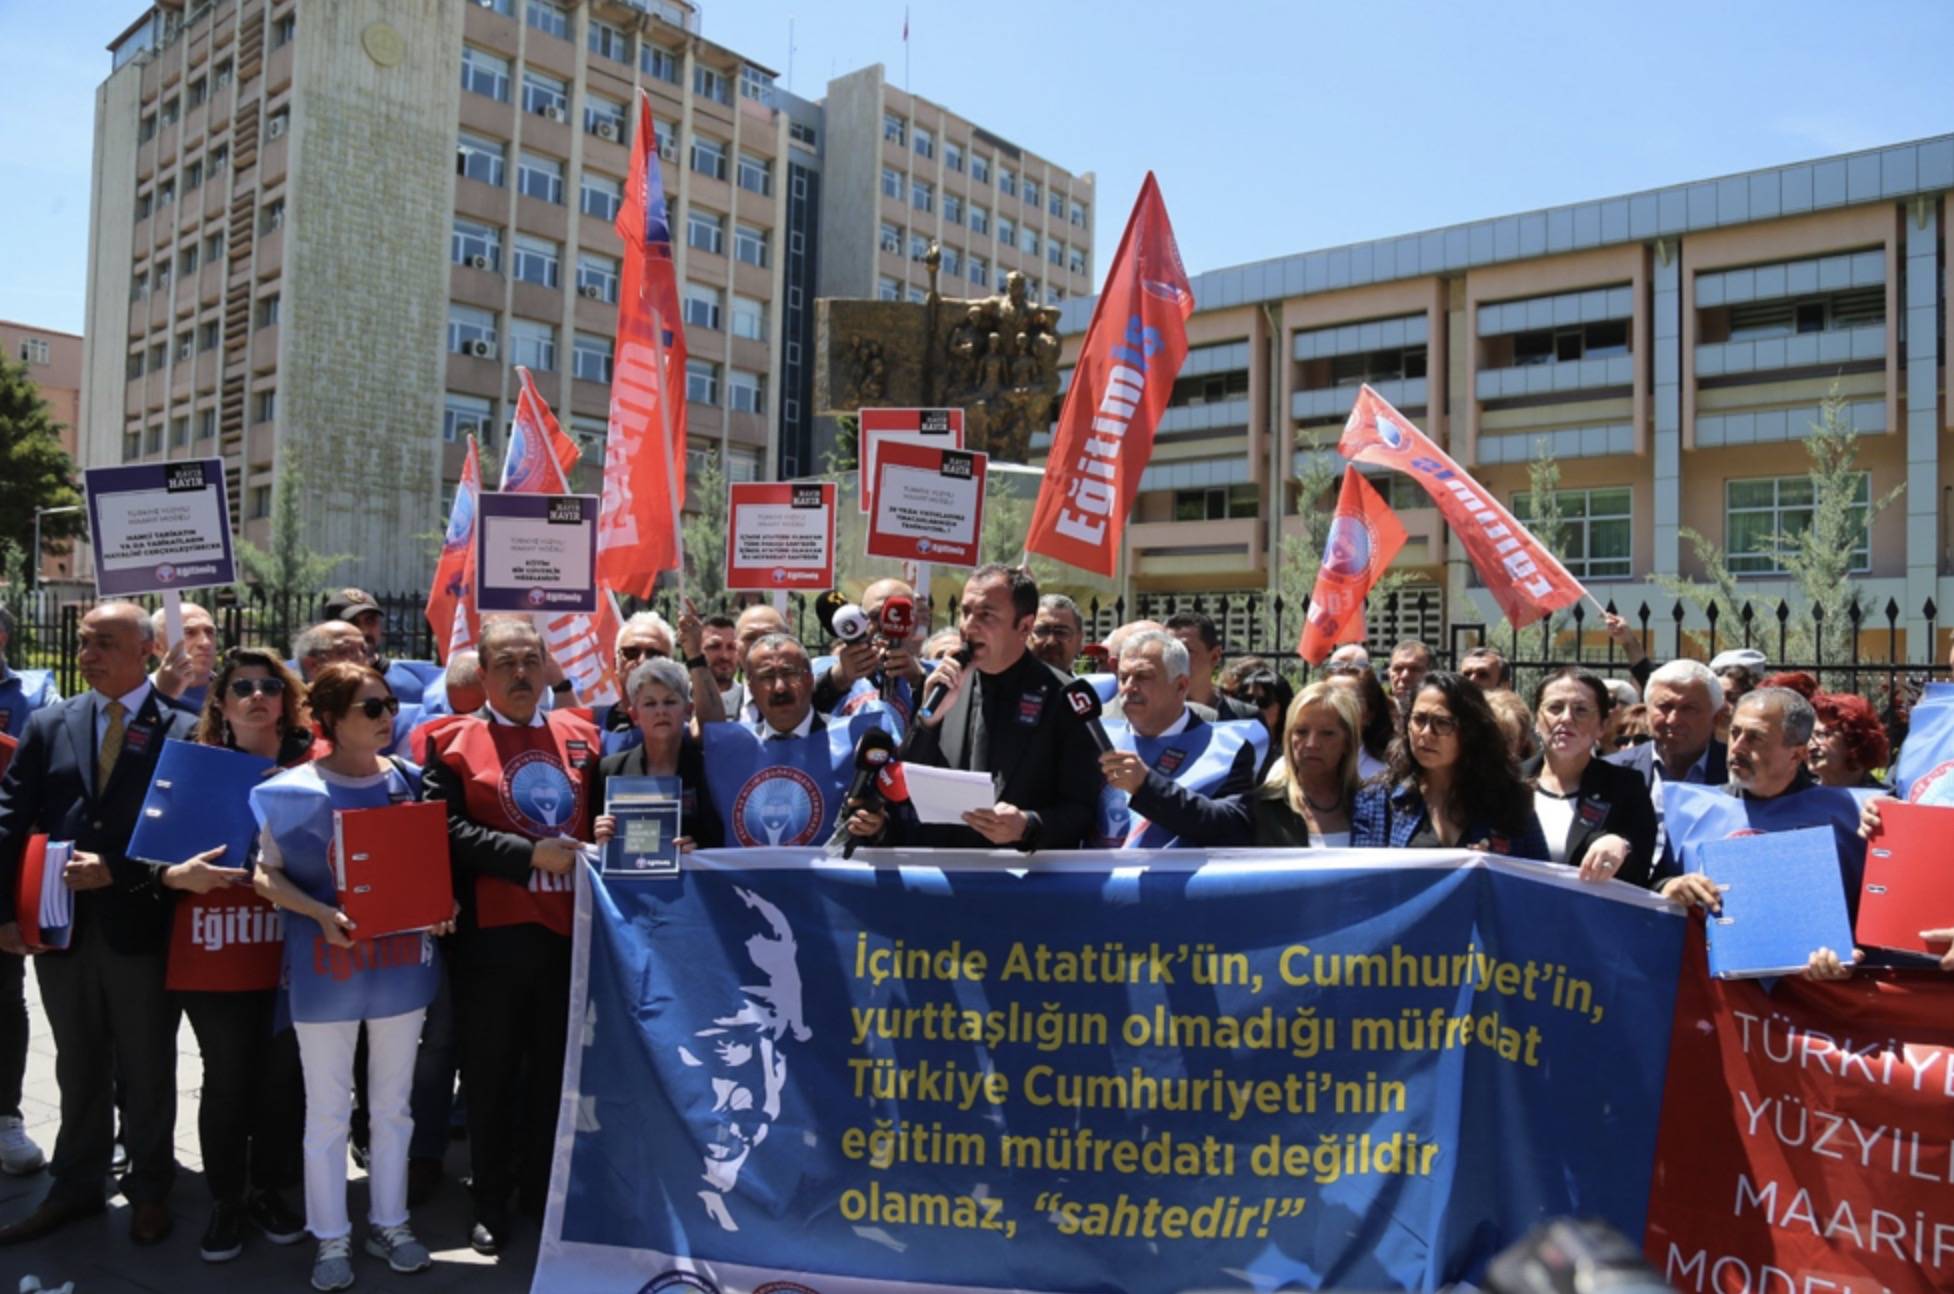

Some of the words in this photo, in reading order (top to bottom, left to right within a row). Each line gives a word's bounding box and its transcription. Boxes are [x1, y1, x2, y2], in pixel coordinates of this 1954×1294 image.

[168, 477, 204, 489] HAYIR
[549, 511, 581, 521] HAYIR
[855, 931, 988, 985] İçinde
[1000, 941, 1263, 994] Atatürk’ün,
[1279, 943, 1604, 1024] Cumhuriyet’in,
[851, 1002, 1108, 1051] yurttaşlığın
[1122, 1004, 1335, 1058] olmadığı
[1352, 1008, 1542, 1067] müfredat
[848, 1058, 1009, 1110] Türkiye
[1024, 1065, 1407, 1121] Cumhuriyeti’nin
[841, 1118, 986, 1169] eğitim
[1001, 1127, 1235, 1176] müfredatı
[1250, 1133, 1439, 1184] değildir
[839, 1181, 1017, 1239] olamaz,
